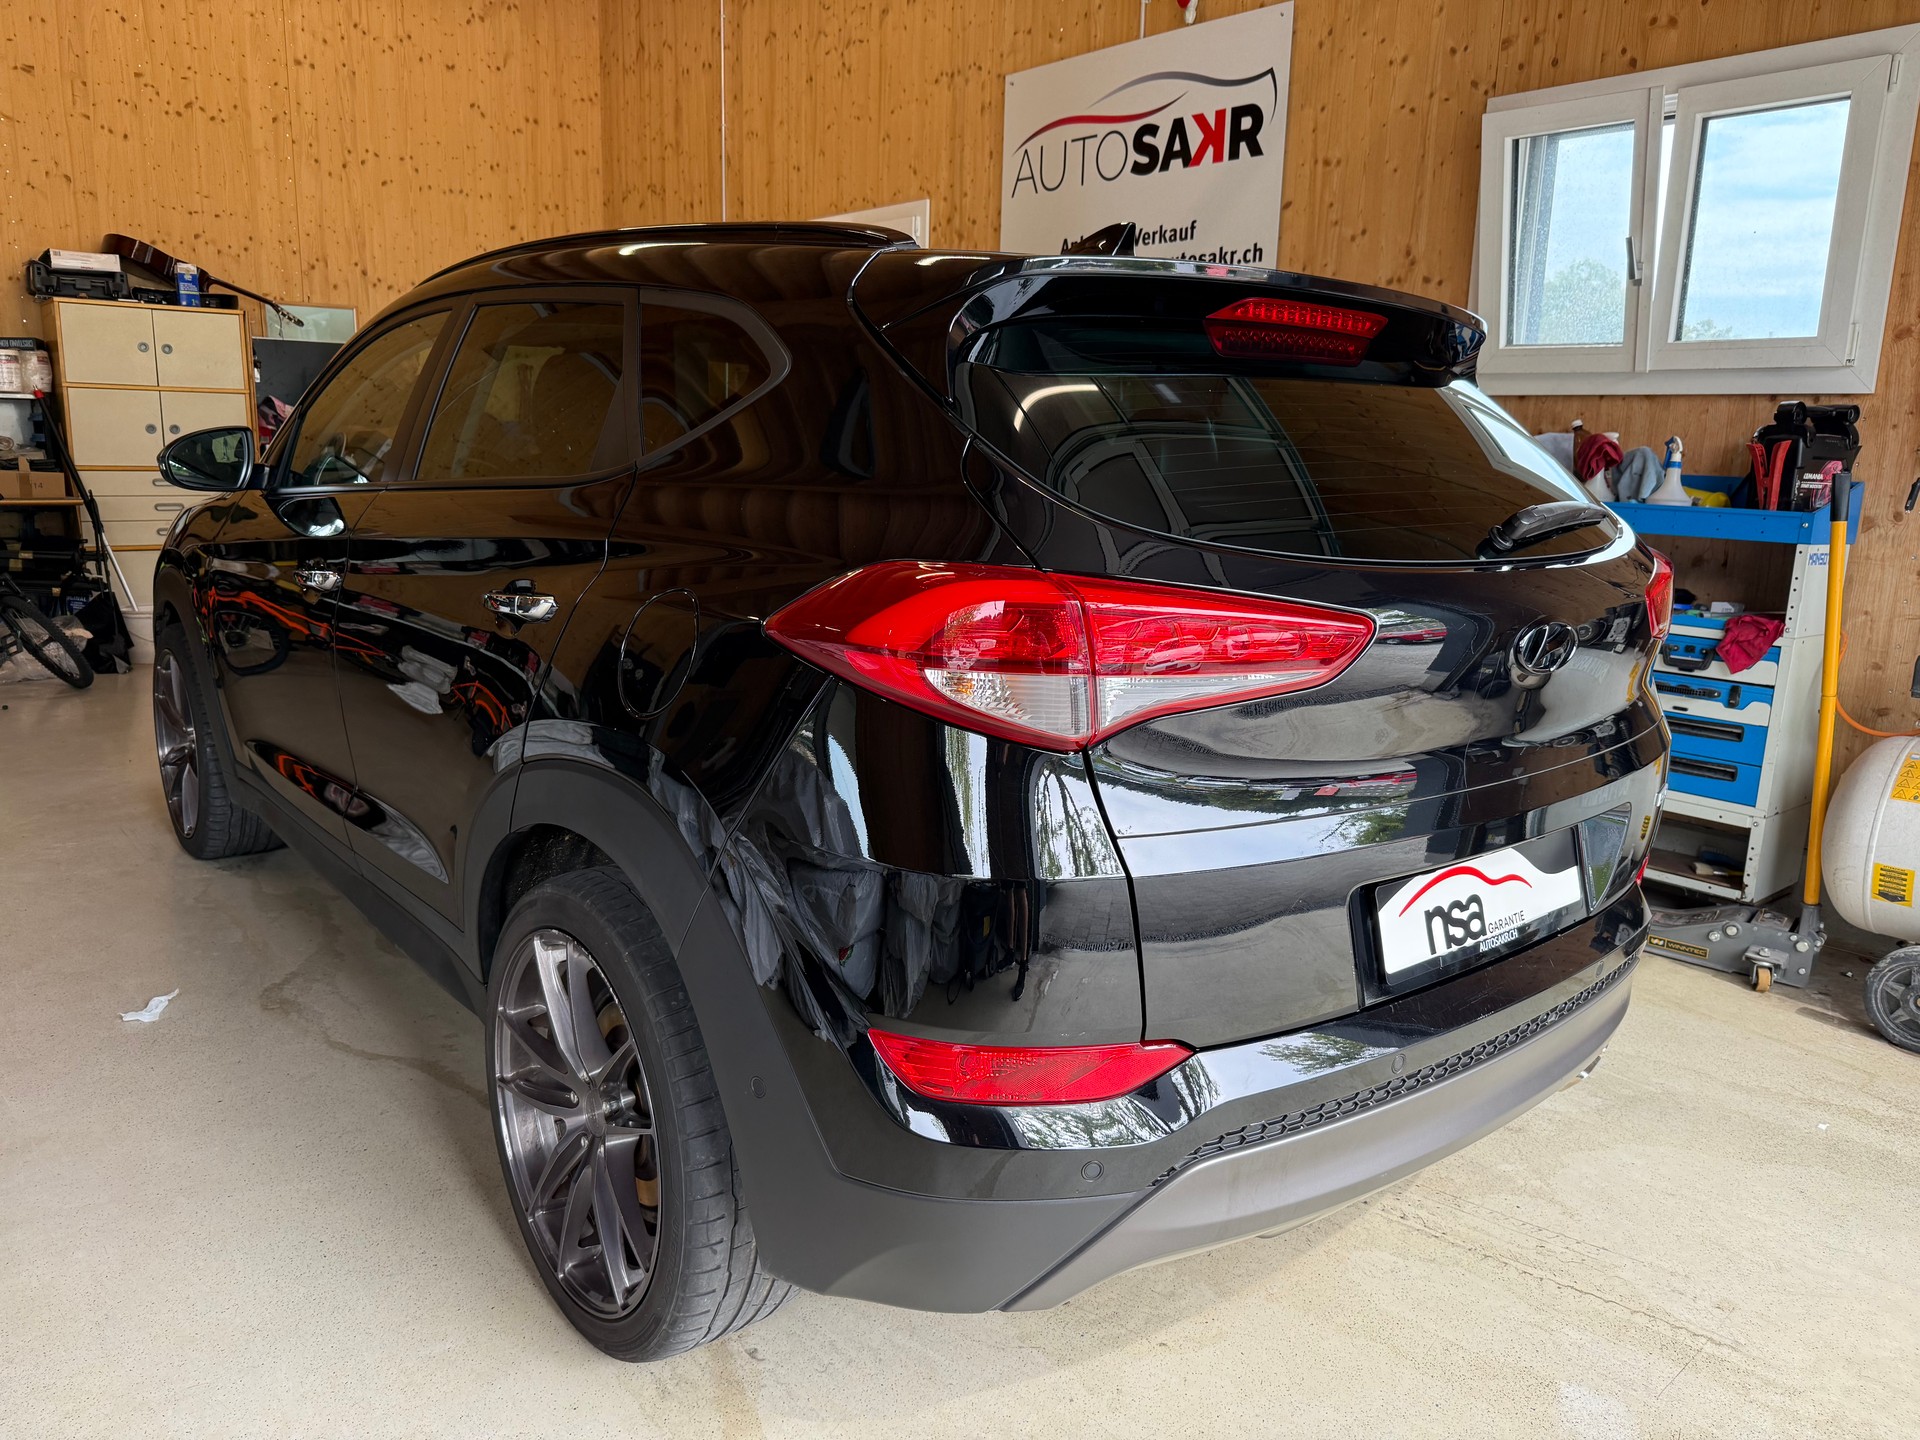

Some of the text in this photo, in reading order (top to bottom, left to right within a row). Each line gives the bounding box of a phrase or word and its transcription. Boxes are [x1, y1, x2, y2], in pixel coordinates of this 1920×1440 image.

[1011, 103, 1264, 198] AUTOSAKR
[1134, 220, 1197, 248] Verkauf
[1424, 894, 1525, 955] nsa GARANTIE
[1479, 928, 1518, 953] AUTOSAKR.CH
